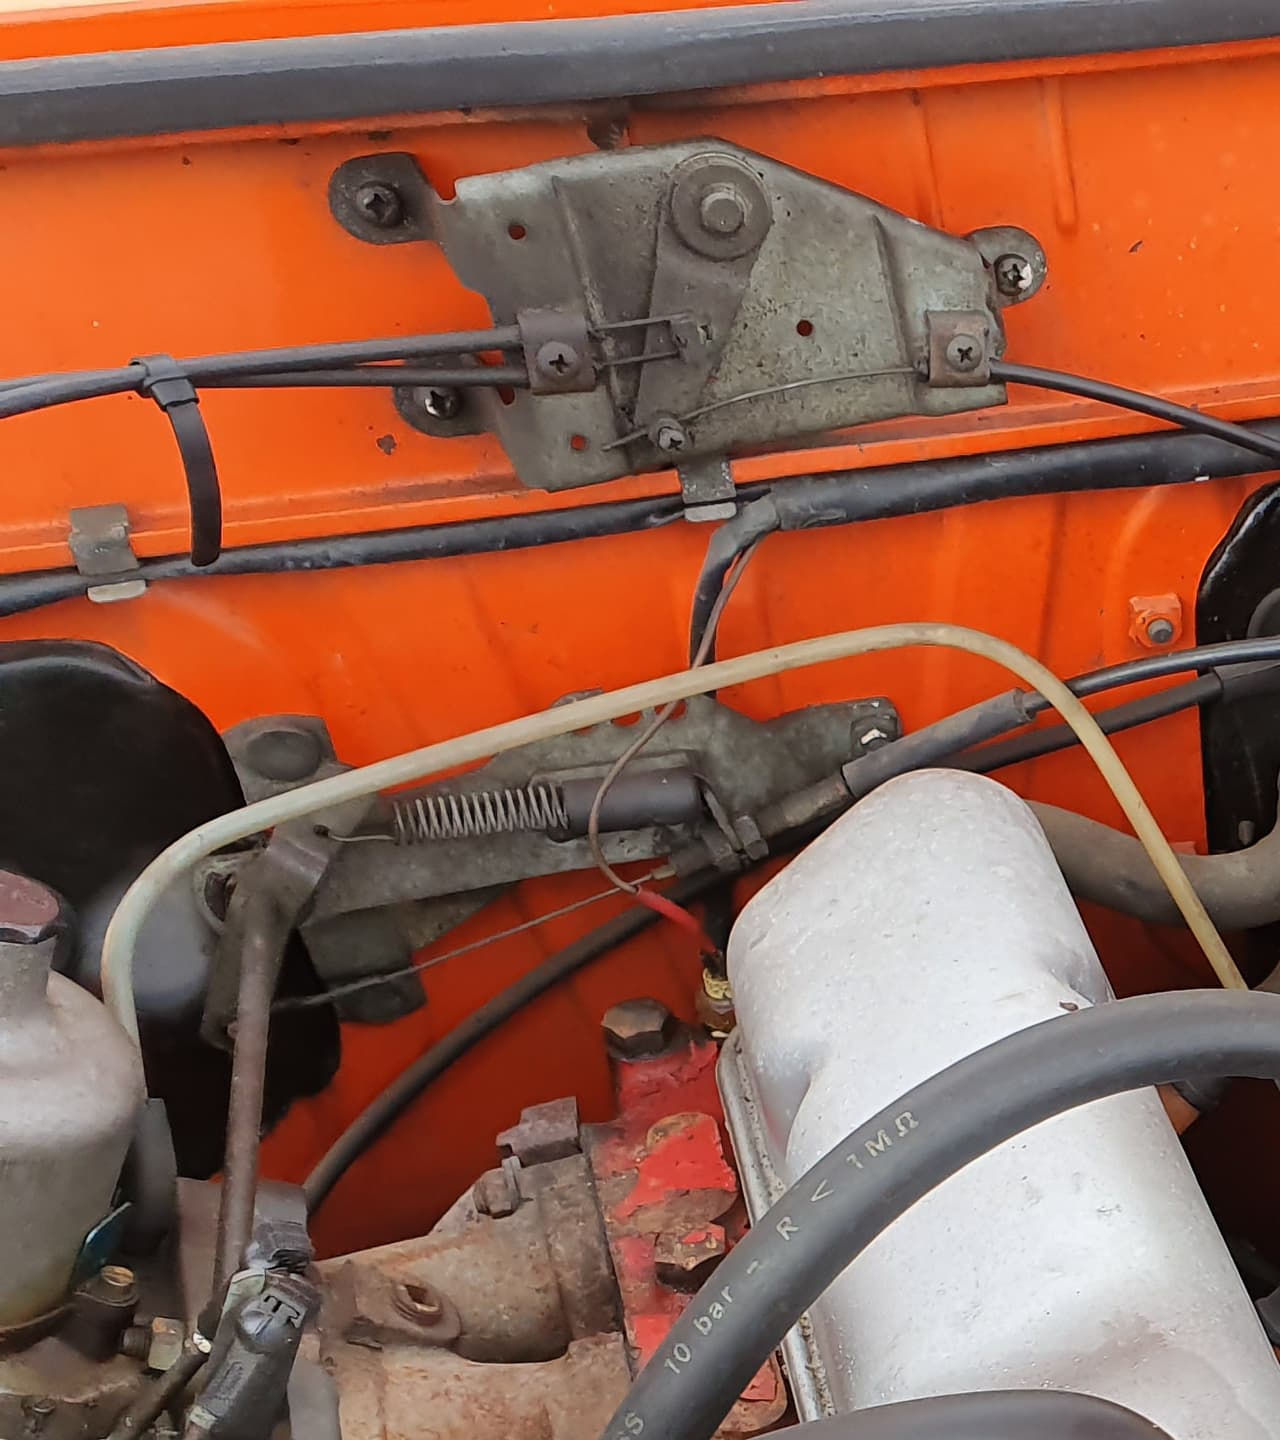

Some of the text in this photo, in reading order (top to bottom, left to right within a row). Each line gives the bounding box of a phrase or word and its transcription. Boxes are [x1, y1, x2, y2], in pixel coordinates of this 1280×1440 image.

[663, 1342, 692, 1375] 10
[693, 1285, 735, 1336] bar
[775, 1215, 801, 1241] R
